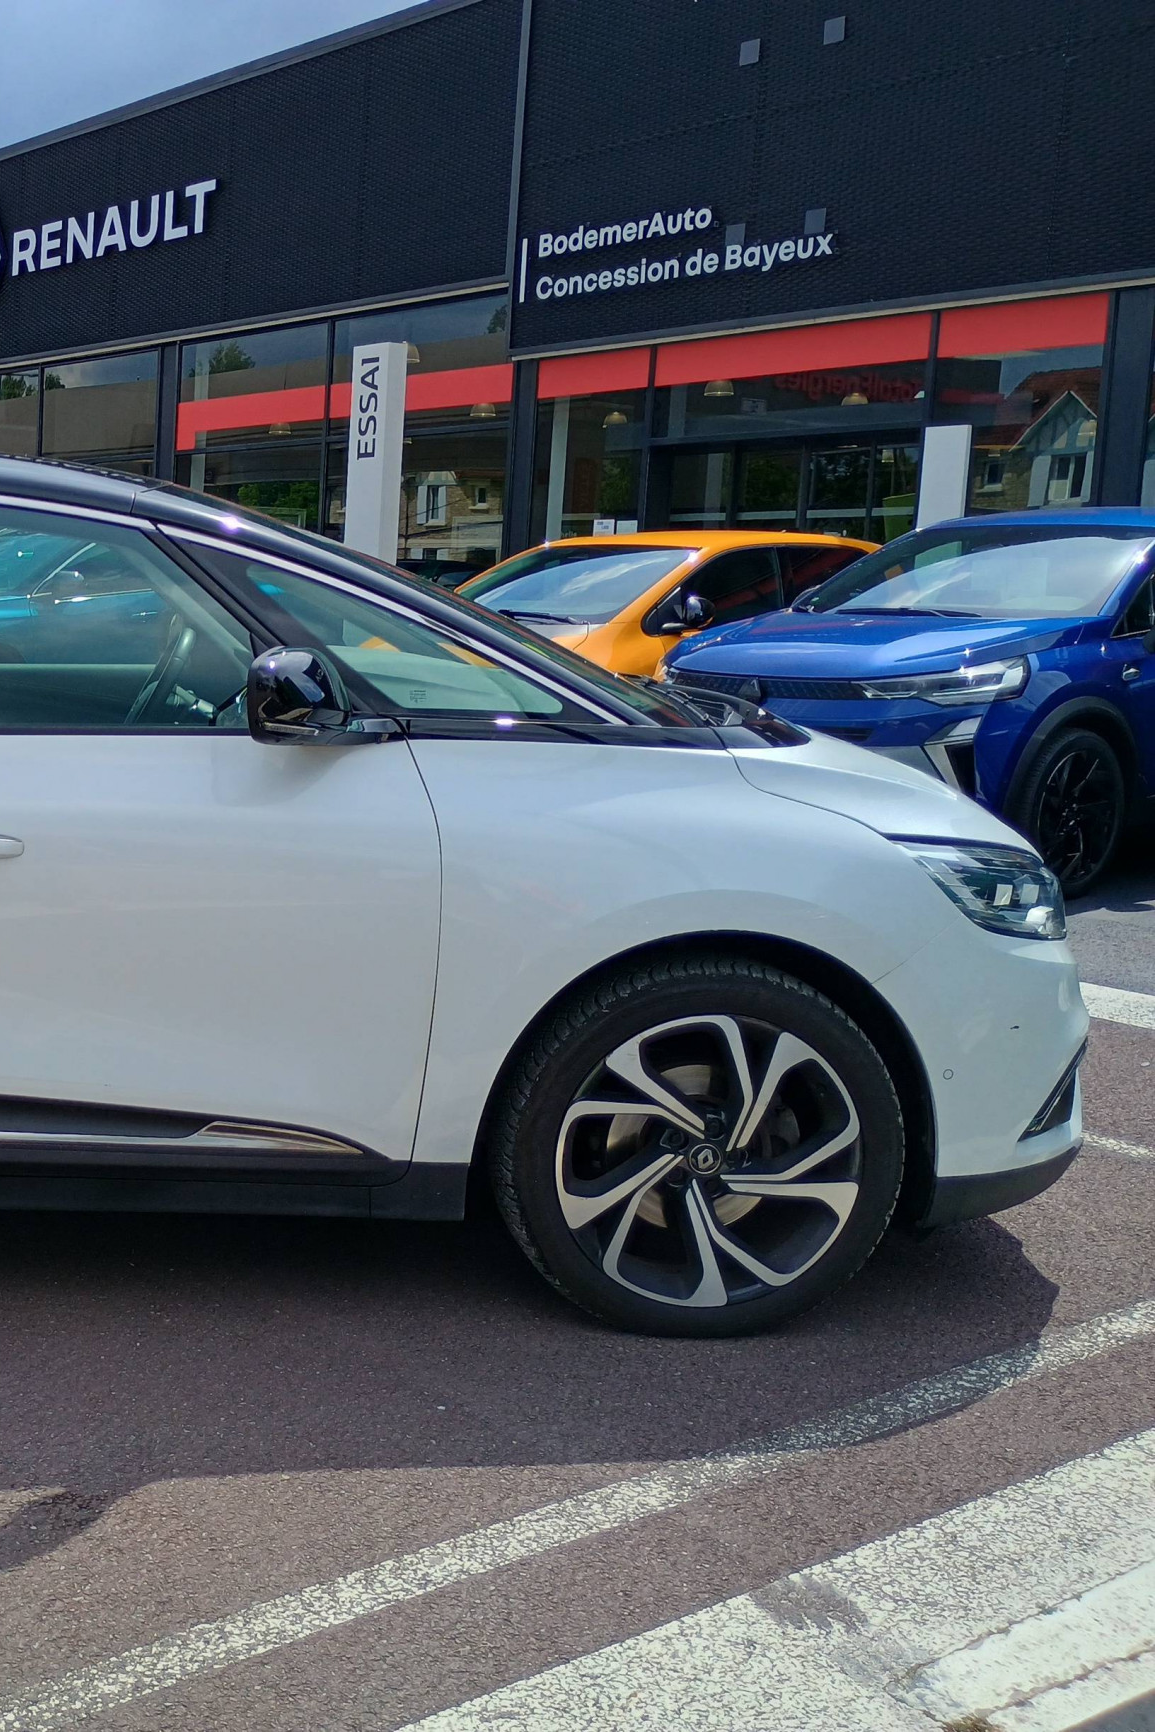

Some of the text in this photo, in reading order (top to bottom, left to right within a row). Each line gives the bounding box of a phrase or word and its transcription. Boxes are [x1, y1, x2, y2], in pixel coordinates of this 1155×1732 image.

[11, 178, 218, 277] RENAULT
[535, 232, 835, 300] Concession de Bayeux
[537, 207, 713, 258] BodemerAuto
[356, 356, 380, 461] ESSAI
